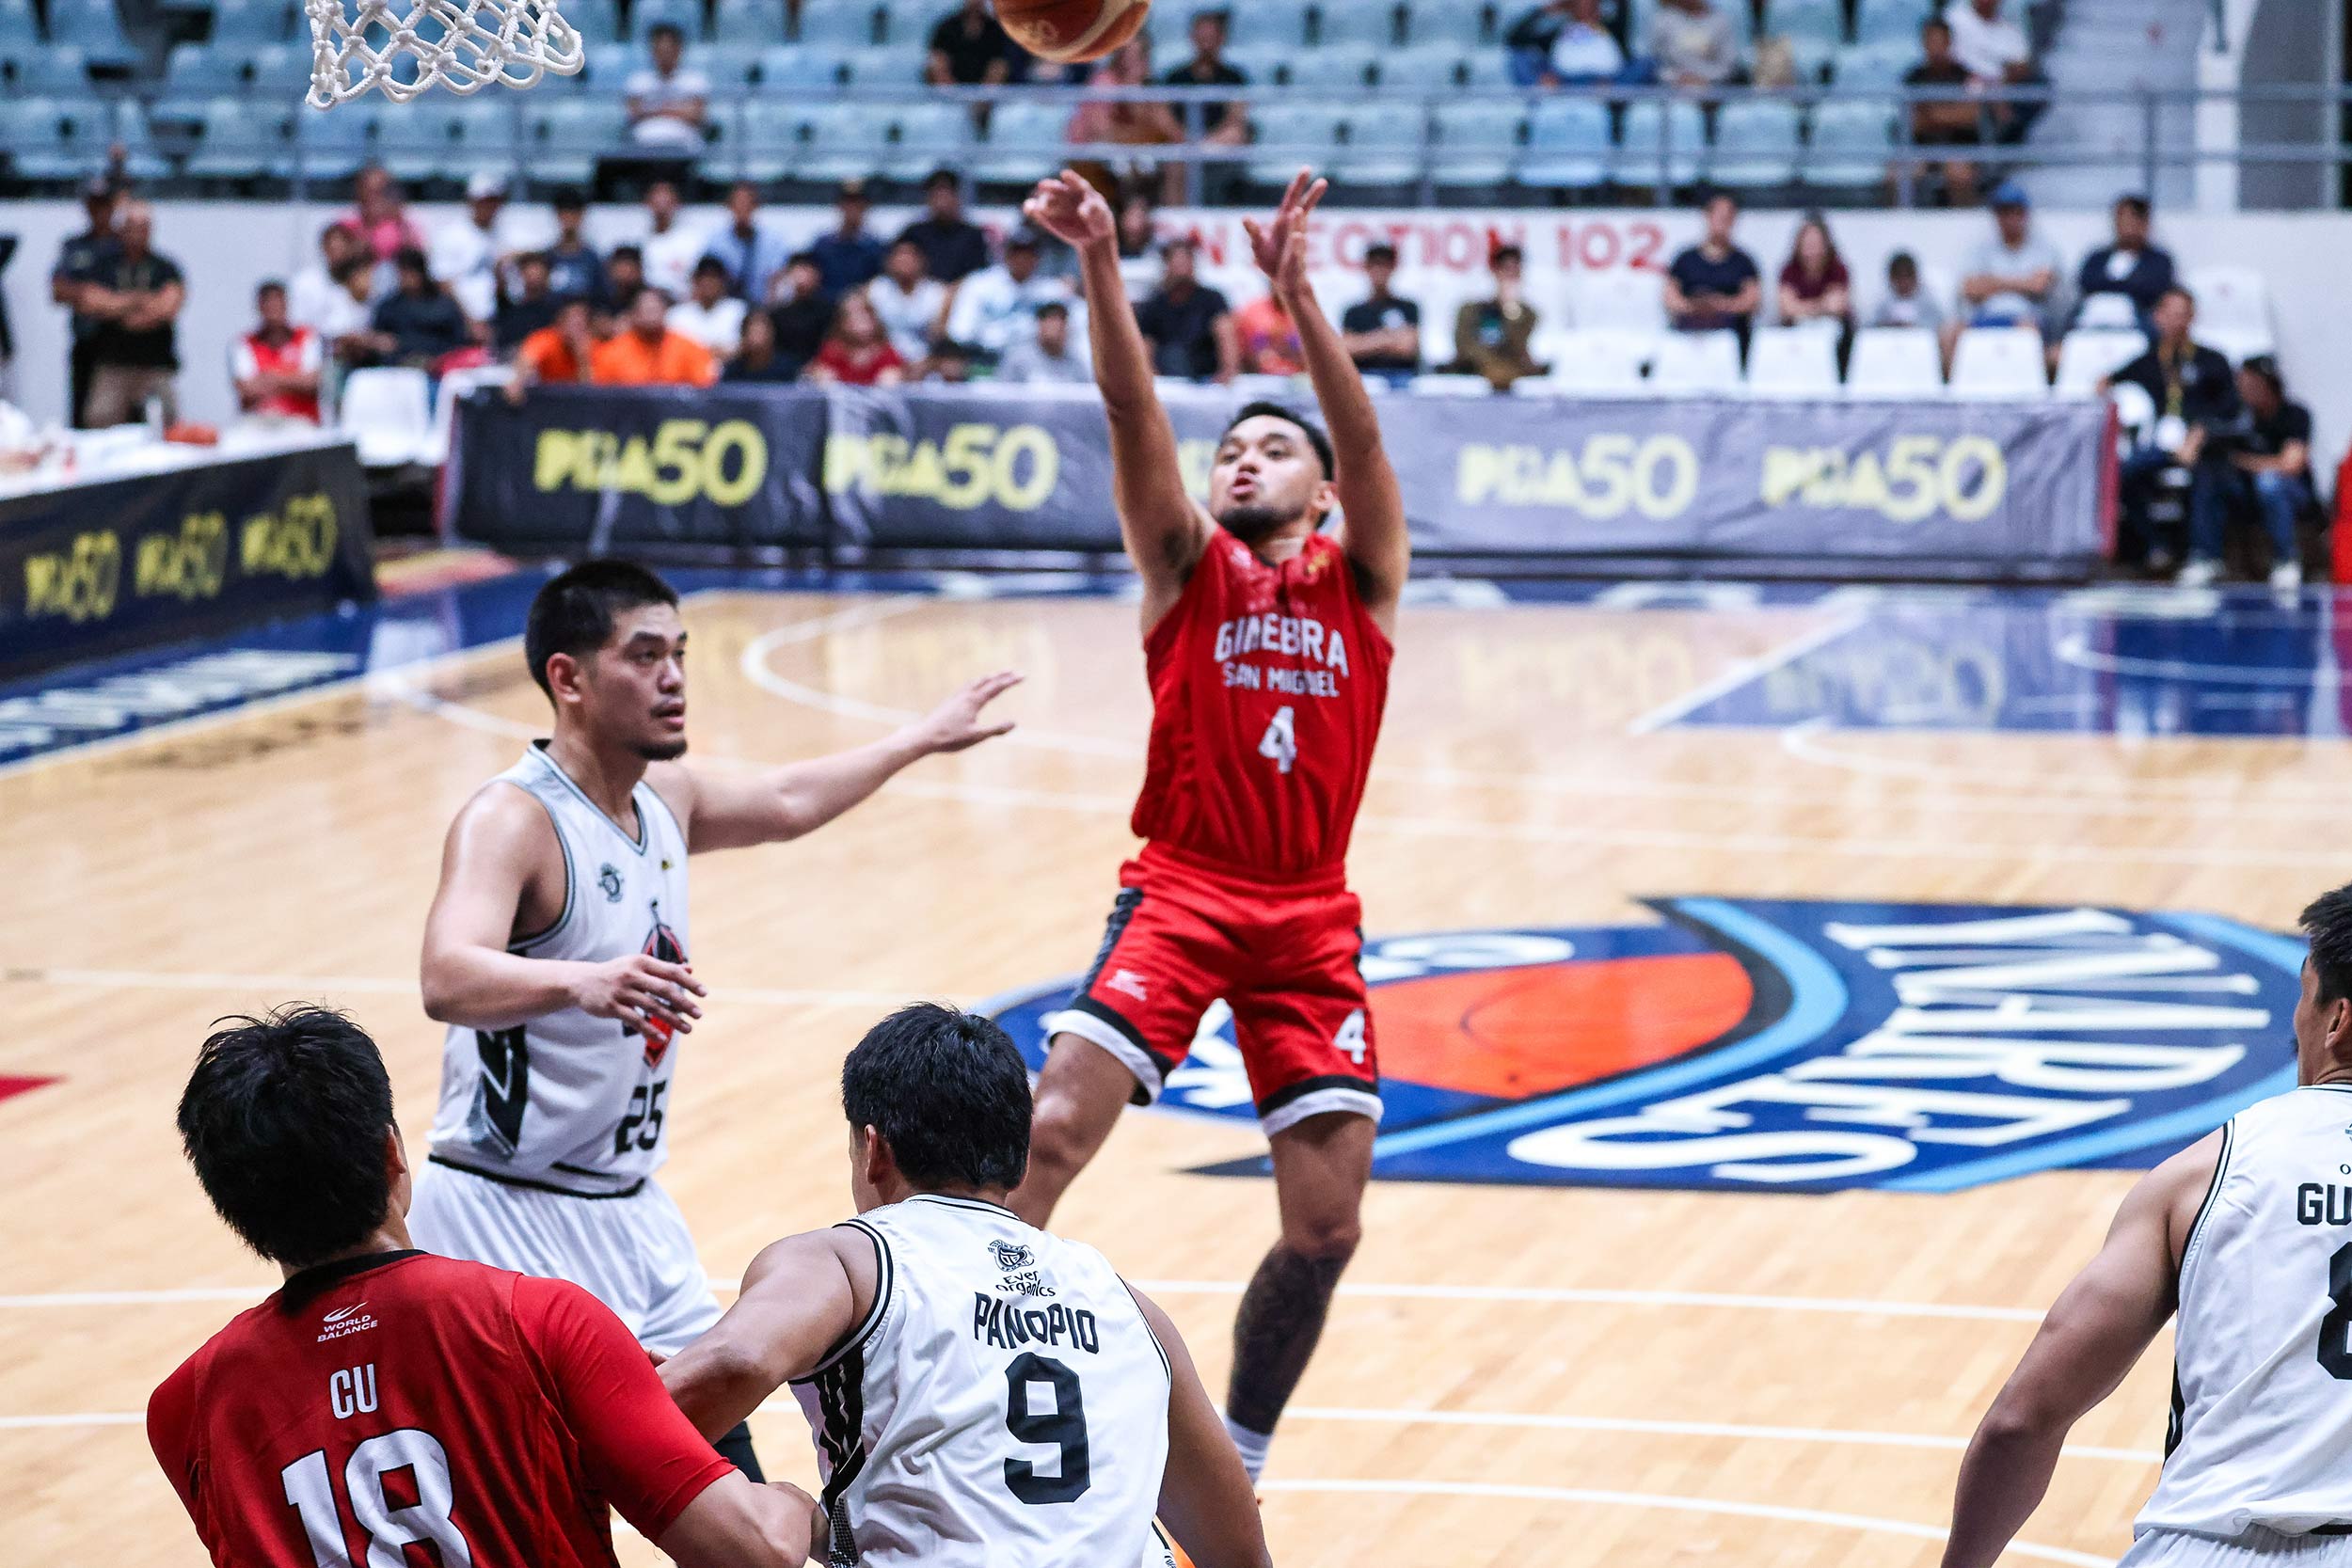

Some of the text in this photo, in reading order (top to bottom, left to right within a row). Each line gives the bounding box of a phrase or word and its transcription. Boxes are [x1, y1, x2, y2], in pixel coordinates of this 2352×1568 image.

[1558, 223, 1669, 274] 102
[1214, 612, 1349, 678] GINEBRA
[1223, 661, 1261, 689] SAN
[1257, 705, 1297, 774] 4
[1332, 1008, 1368, 1066] 4
[614, 1080, 667, 1155] 25
[317, 1319, 378, 1342] BALANCE
[324, 1314, 372, 1334] WORLD
[975, 1291, 1099, 1354] PANOPIO
[329, 1363, 378, 1419] CU
[1004, 1352, 1091, 1505] 9
[281, 1429, 472, 1568] 18
